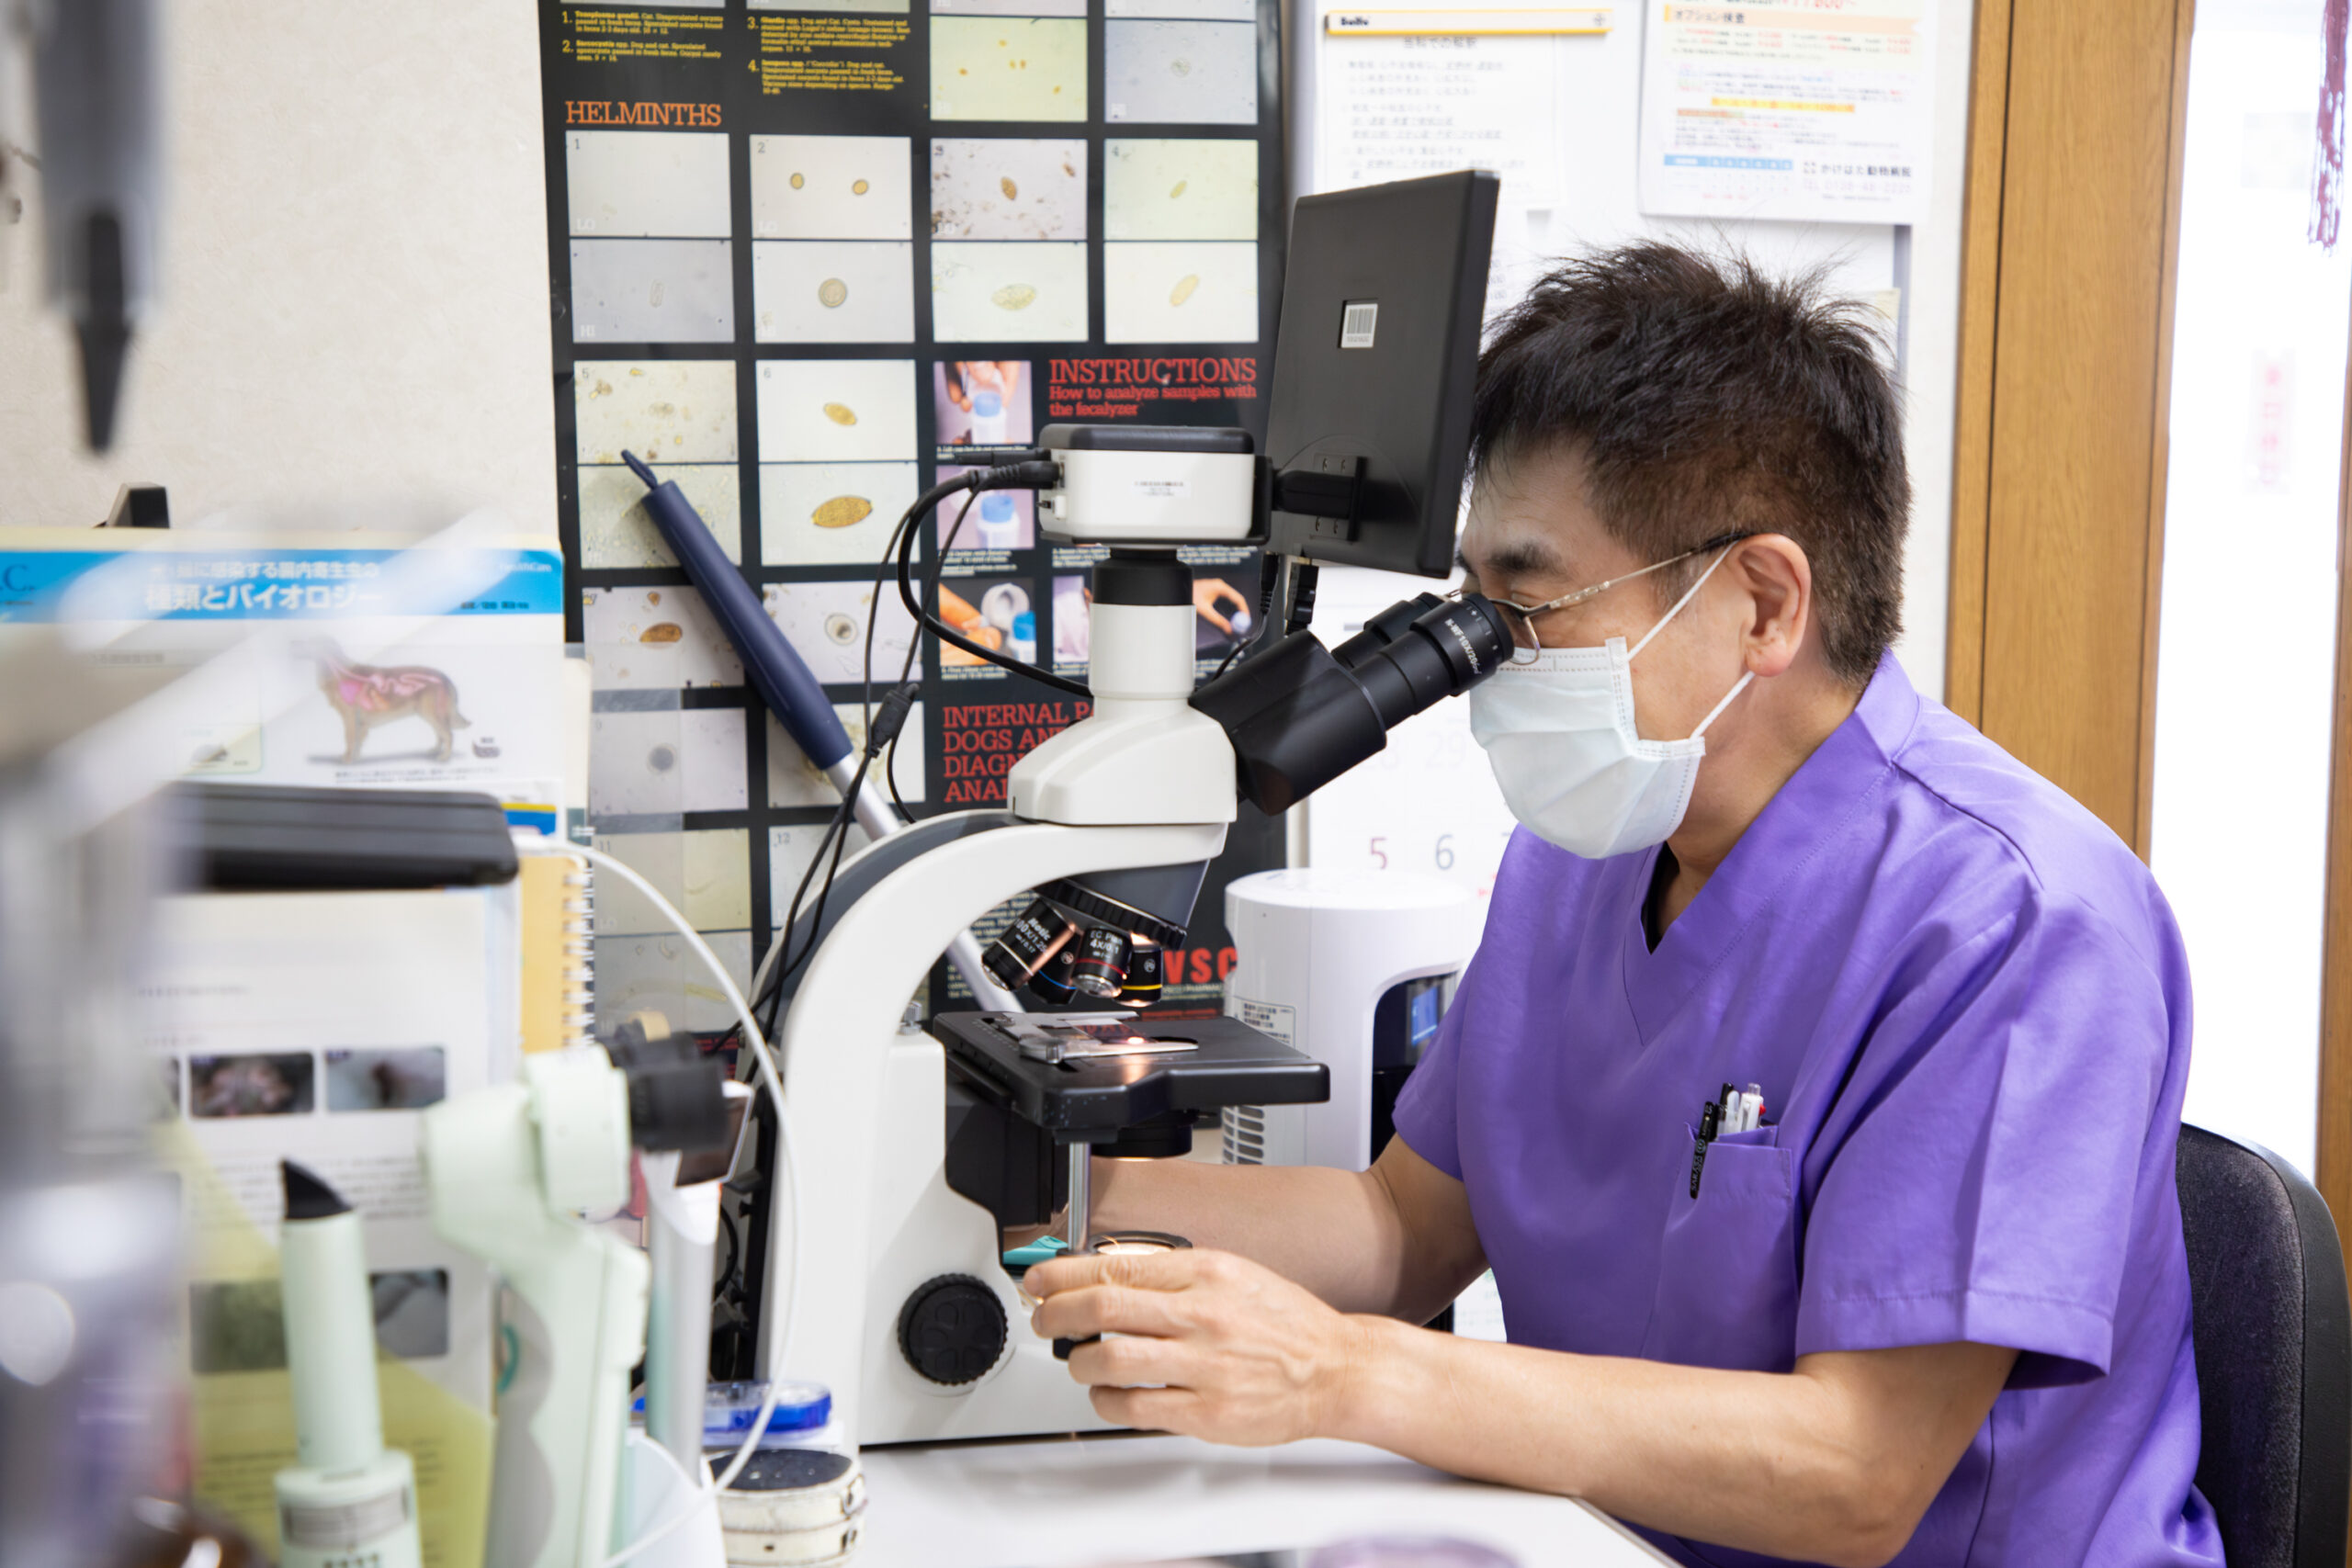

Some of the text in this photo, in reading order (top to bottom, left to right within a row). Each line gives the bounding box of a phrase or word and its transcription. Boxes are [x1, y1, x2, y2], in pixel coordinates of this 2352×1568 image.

[565, 100, 722, 127] HELMINTHS
[758, 141, 766, 153] 2
[1049, 358, 1257, 384] INSTRUCTIONS
[1049, 384, 1258, 403] How to analyze samples with
[1049, 401, 1073, 416] the
[147, 583, 383, 610] 種類とバイオロジー
[943, 701, 1094, 728] INTERNAL P
[943, 727, 1066, 753] DOGS AN
[1369, 834, 1455, 870] 5 6
[1027, 917, 1051, 942] Motic
